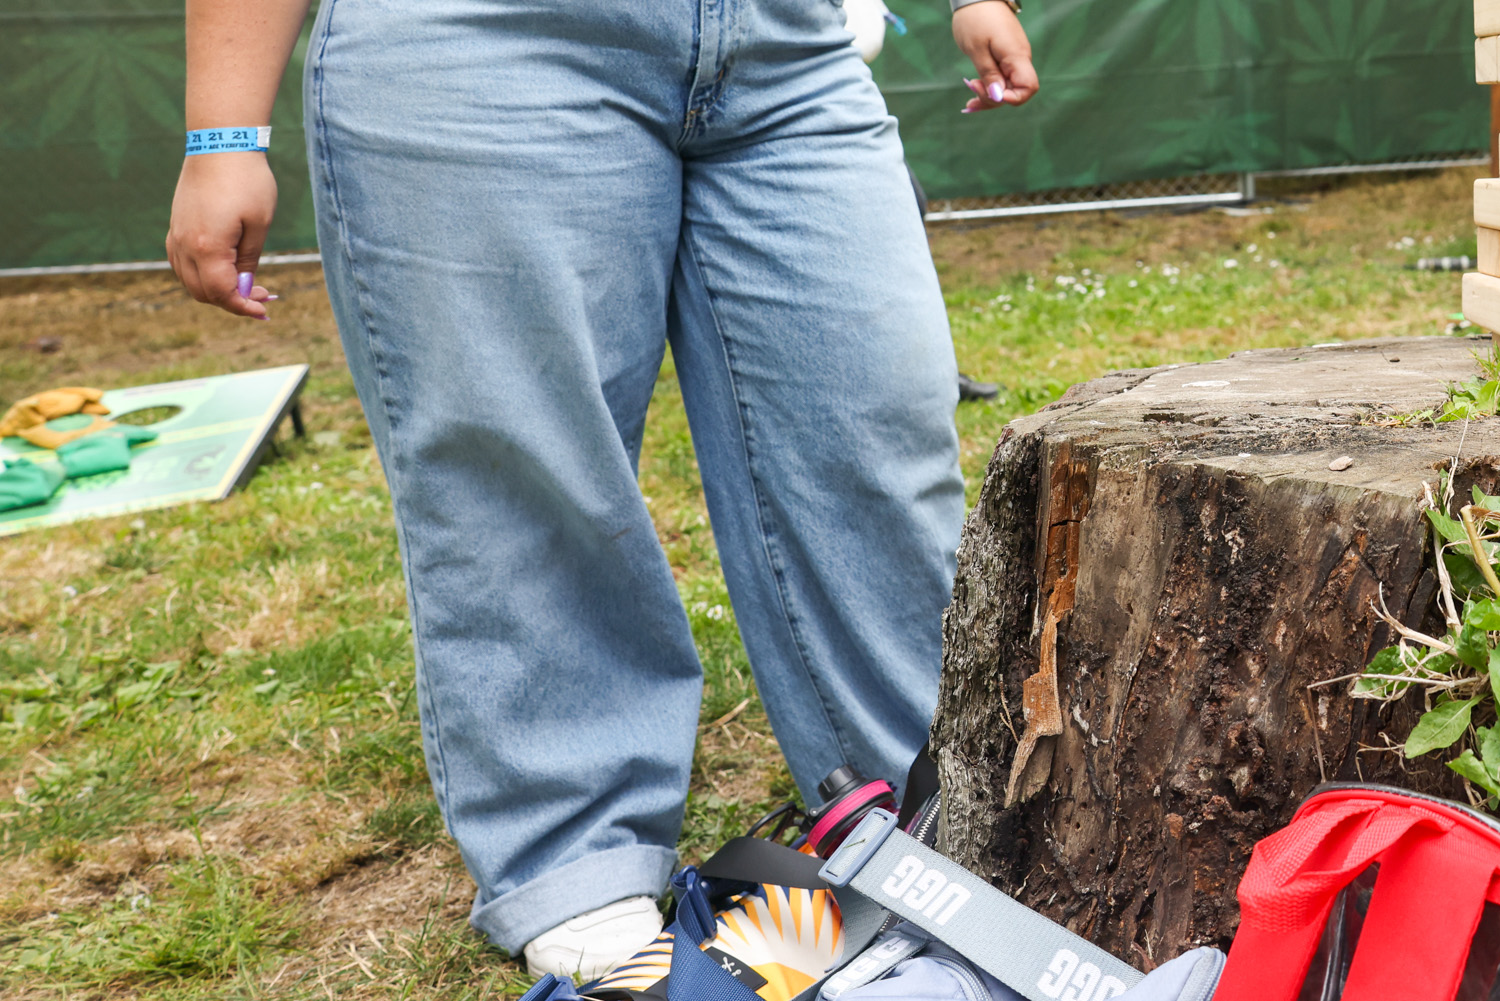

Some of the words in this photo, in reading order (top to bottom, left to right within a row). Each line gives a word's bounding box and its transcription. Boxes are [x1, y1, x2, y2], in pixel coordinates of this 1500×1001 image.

[208, 132, 224, 141] 21
[232, 131, 249, 140] 21
[881, 854, 972, 926] UGG
